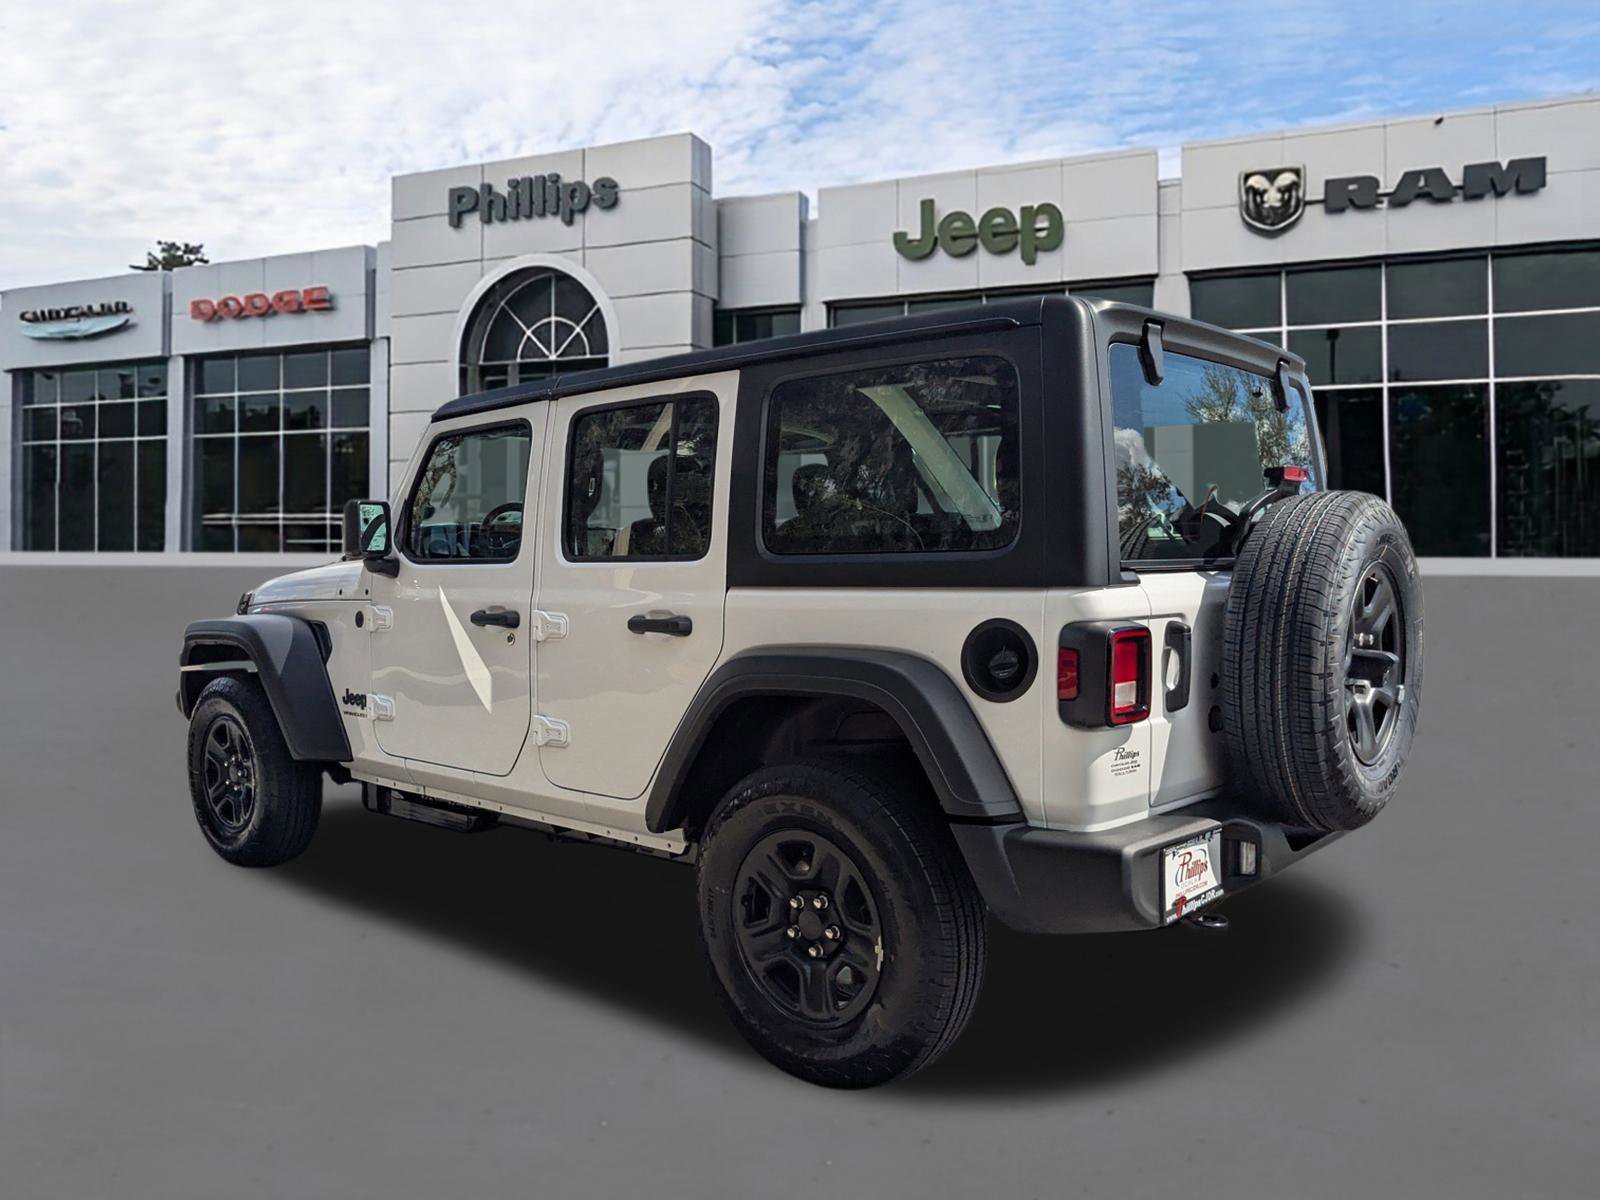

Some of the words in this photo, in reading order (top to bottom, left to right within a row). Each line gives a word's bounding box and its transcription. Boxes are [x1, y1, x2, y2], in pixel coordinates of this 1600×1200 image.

[448, 173, 620, 228] Phillips
[1324, 156, 1547, 213] RAM
[893, 199, 1064, 265] Jeep
[191, 286, 332, 321] DODGE
[341, 688, 367, 711] Jeep
[1113, 746, 1140, 761] Phillips
[1178, 850, 1208, 883] Phillips
